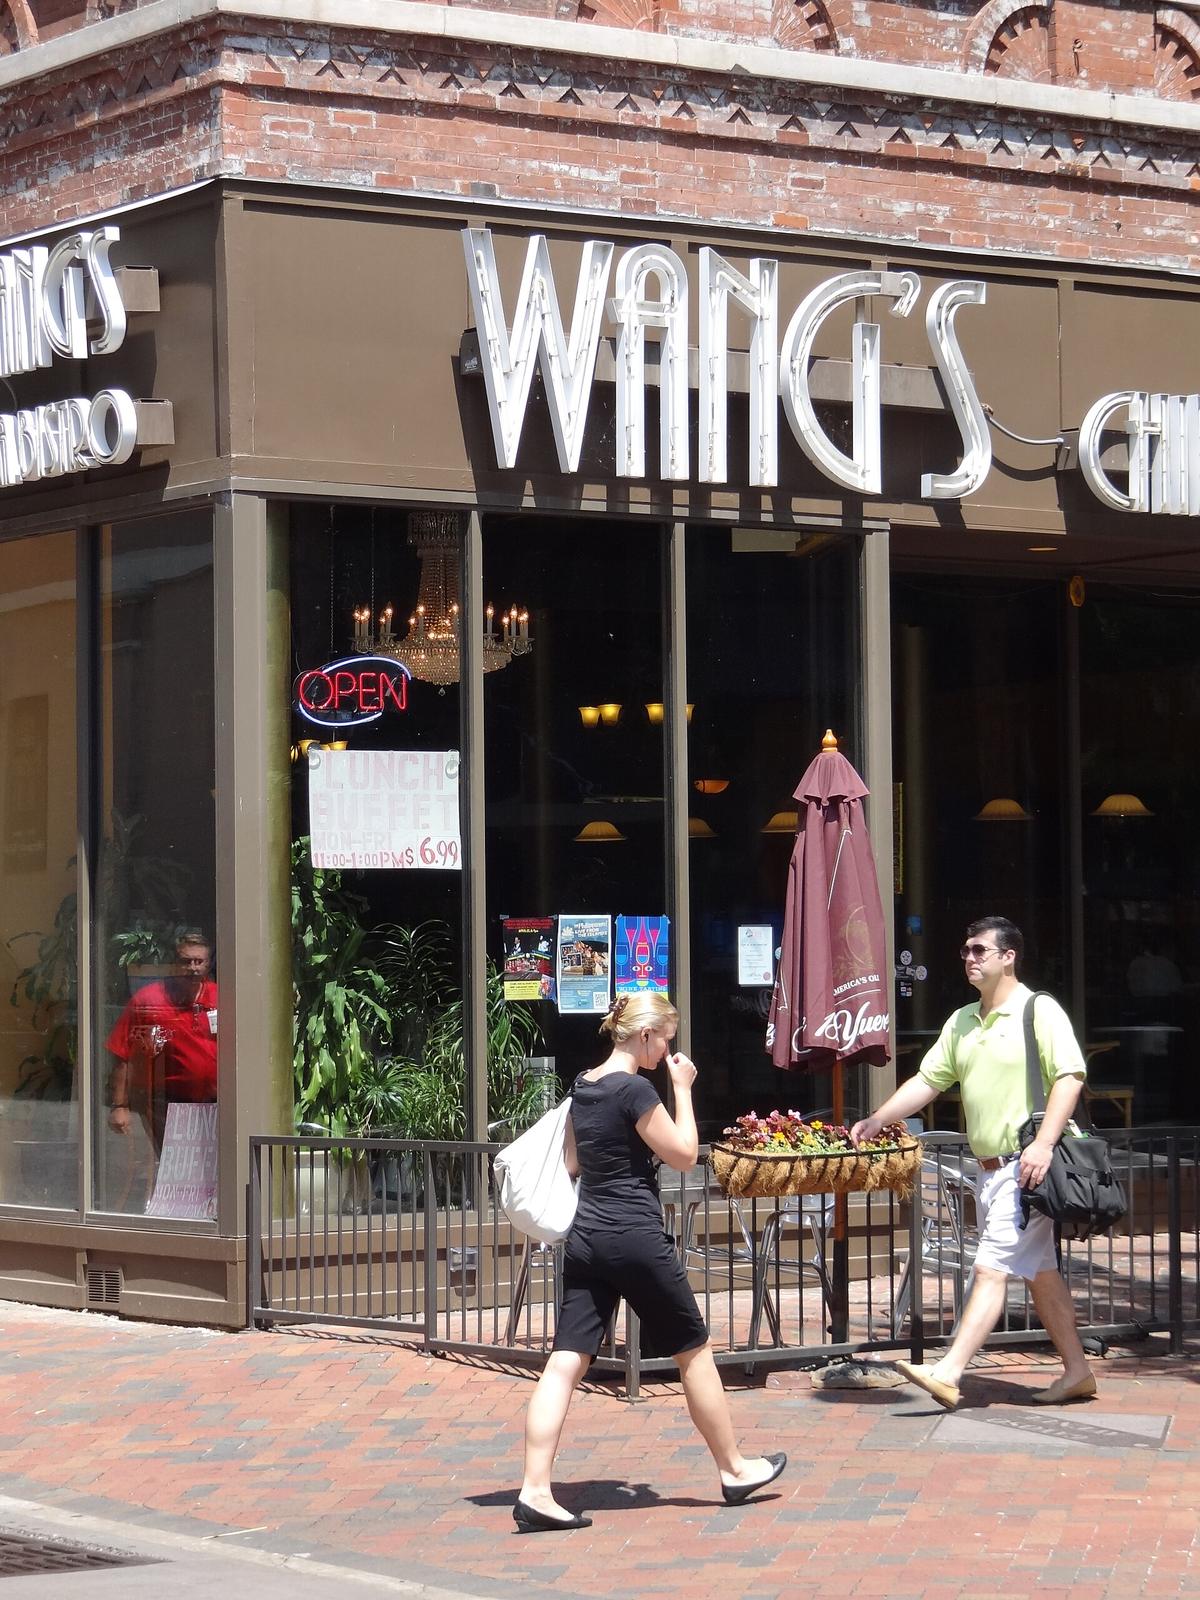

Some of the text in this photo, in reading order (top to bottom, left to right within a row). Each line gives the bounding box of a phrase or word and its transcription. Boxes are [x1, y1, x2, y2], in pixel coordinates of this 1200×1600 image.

[460, 227, 992, 499] WANG'S
[17, 389, 138, 482] BISTRO
[300, 671, 409, 710] OPEN
[325, 751, 444, 790] LUNCH
[312, 792, 458, 831] BUFFET
[832, 977, 868, 996] MERICA'S
[157, 1145, 217, 1182] BUFF
